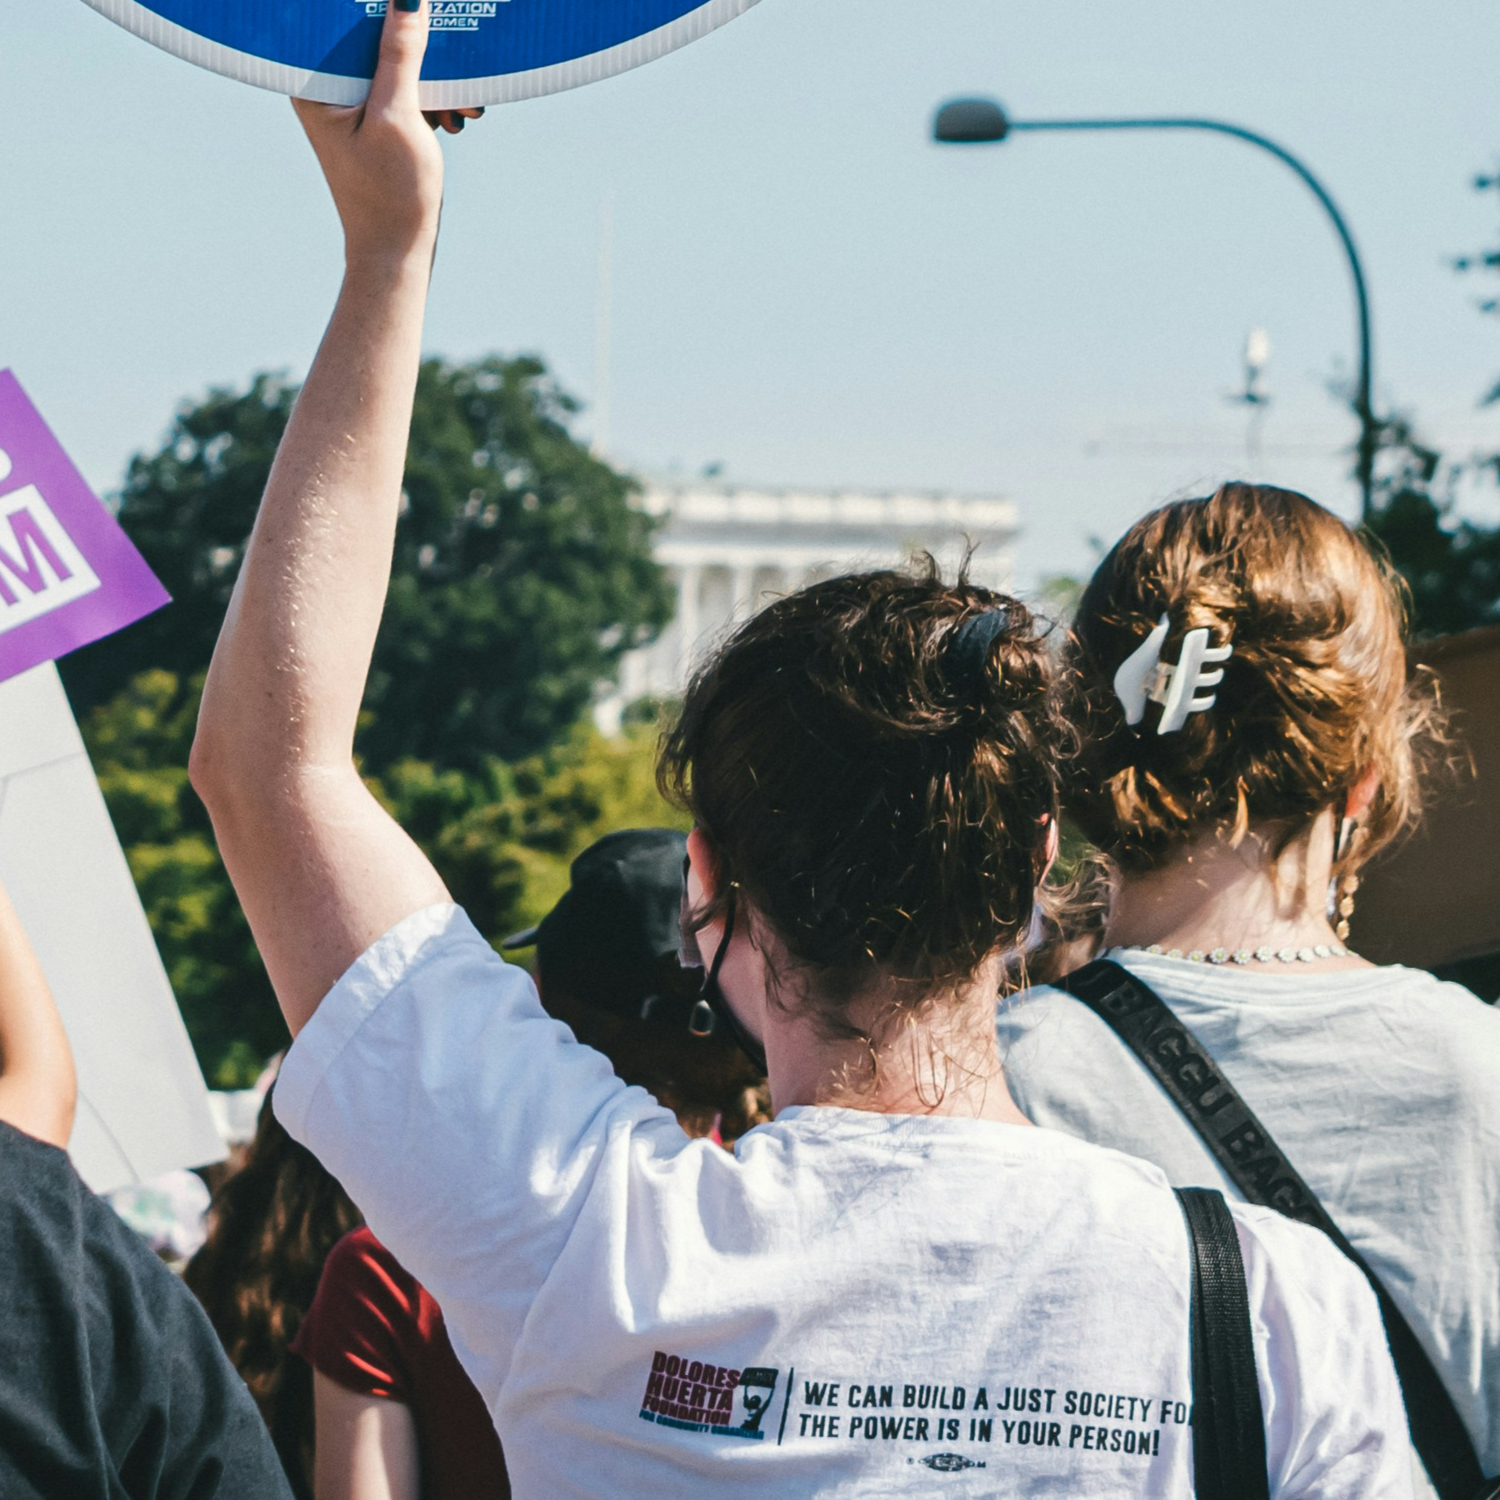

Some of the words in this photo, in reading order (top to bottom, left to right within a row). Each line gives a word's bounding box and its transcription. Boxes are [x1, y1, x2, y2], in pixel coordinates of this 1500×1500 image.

[651, 1350, 741, 1389] DOLORES
[642, 1394, 731, 1426] FOUNDATION
[645, 1371, 733, 1412] HUERTA
[804, 1381, 841, 1406] WE
[848, 1385, 893, 1408] CAN
[902, 1384, 966, 1410] BUILD
[973, 1387, 989, 1411] A
[996, 1387, 1057, 1413] JUST
[1063, 1390, 1152, 1422] SOCIETY
[799, 1413, 841, 1438] THE
[849, 1416, 929, 1441] POWER
[937, 1418, 960, 1440] IS
[969, 1418, 993, 1442] IN
[1002, 1420, 1062, 1446] YOUR
[1068, 1424, 1160, 1456] PERSON!
